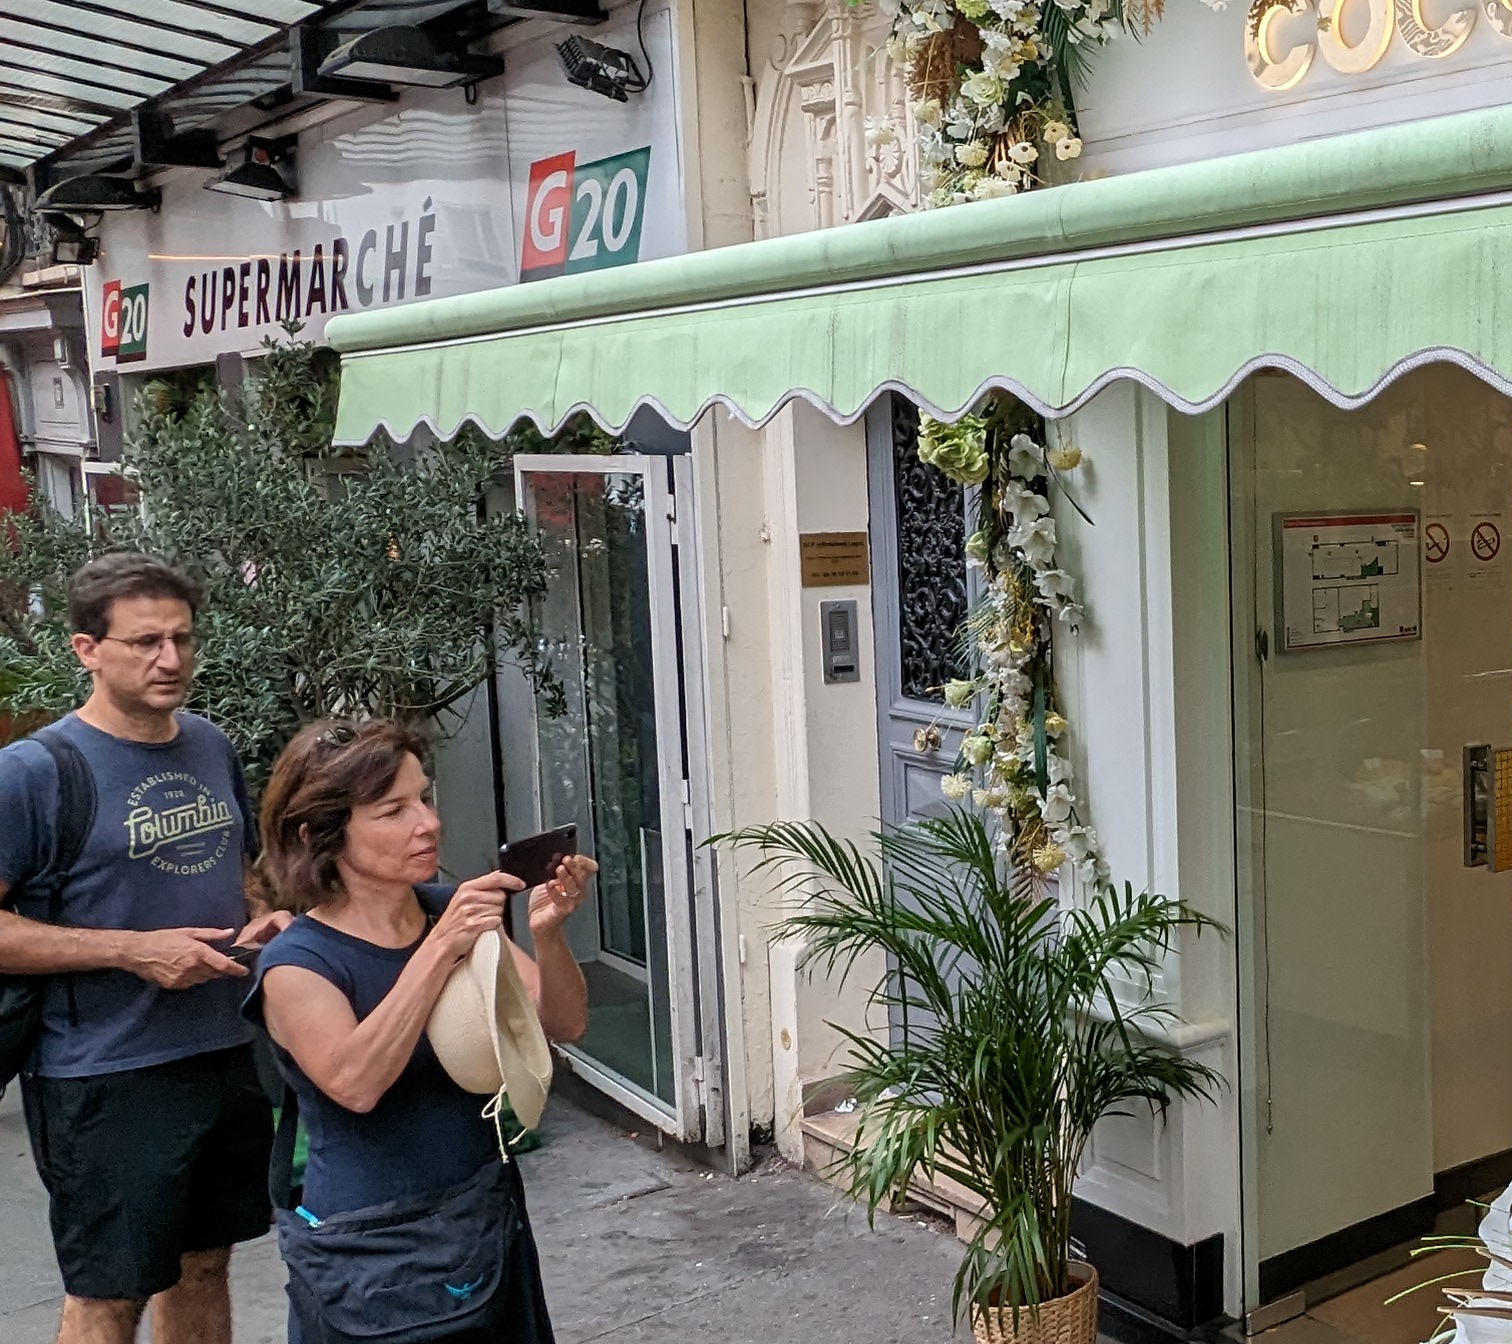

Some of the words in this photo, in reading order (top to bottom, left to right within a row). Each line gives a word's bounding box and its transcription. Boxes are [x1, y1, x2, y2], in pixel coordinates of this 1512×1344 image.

[530, 167, 638, 261] G20
[183, 196, 436, 338] SUPERMARCHÉ
[104, 290, 147, 345] G20
[127, 771, 197, 807] ESTABLISHED
[123, 794, 233, 859] Columbia
[150, 856, 217, 875] EXPLORERS
